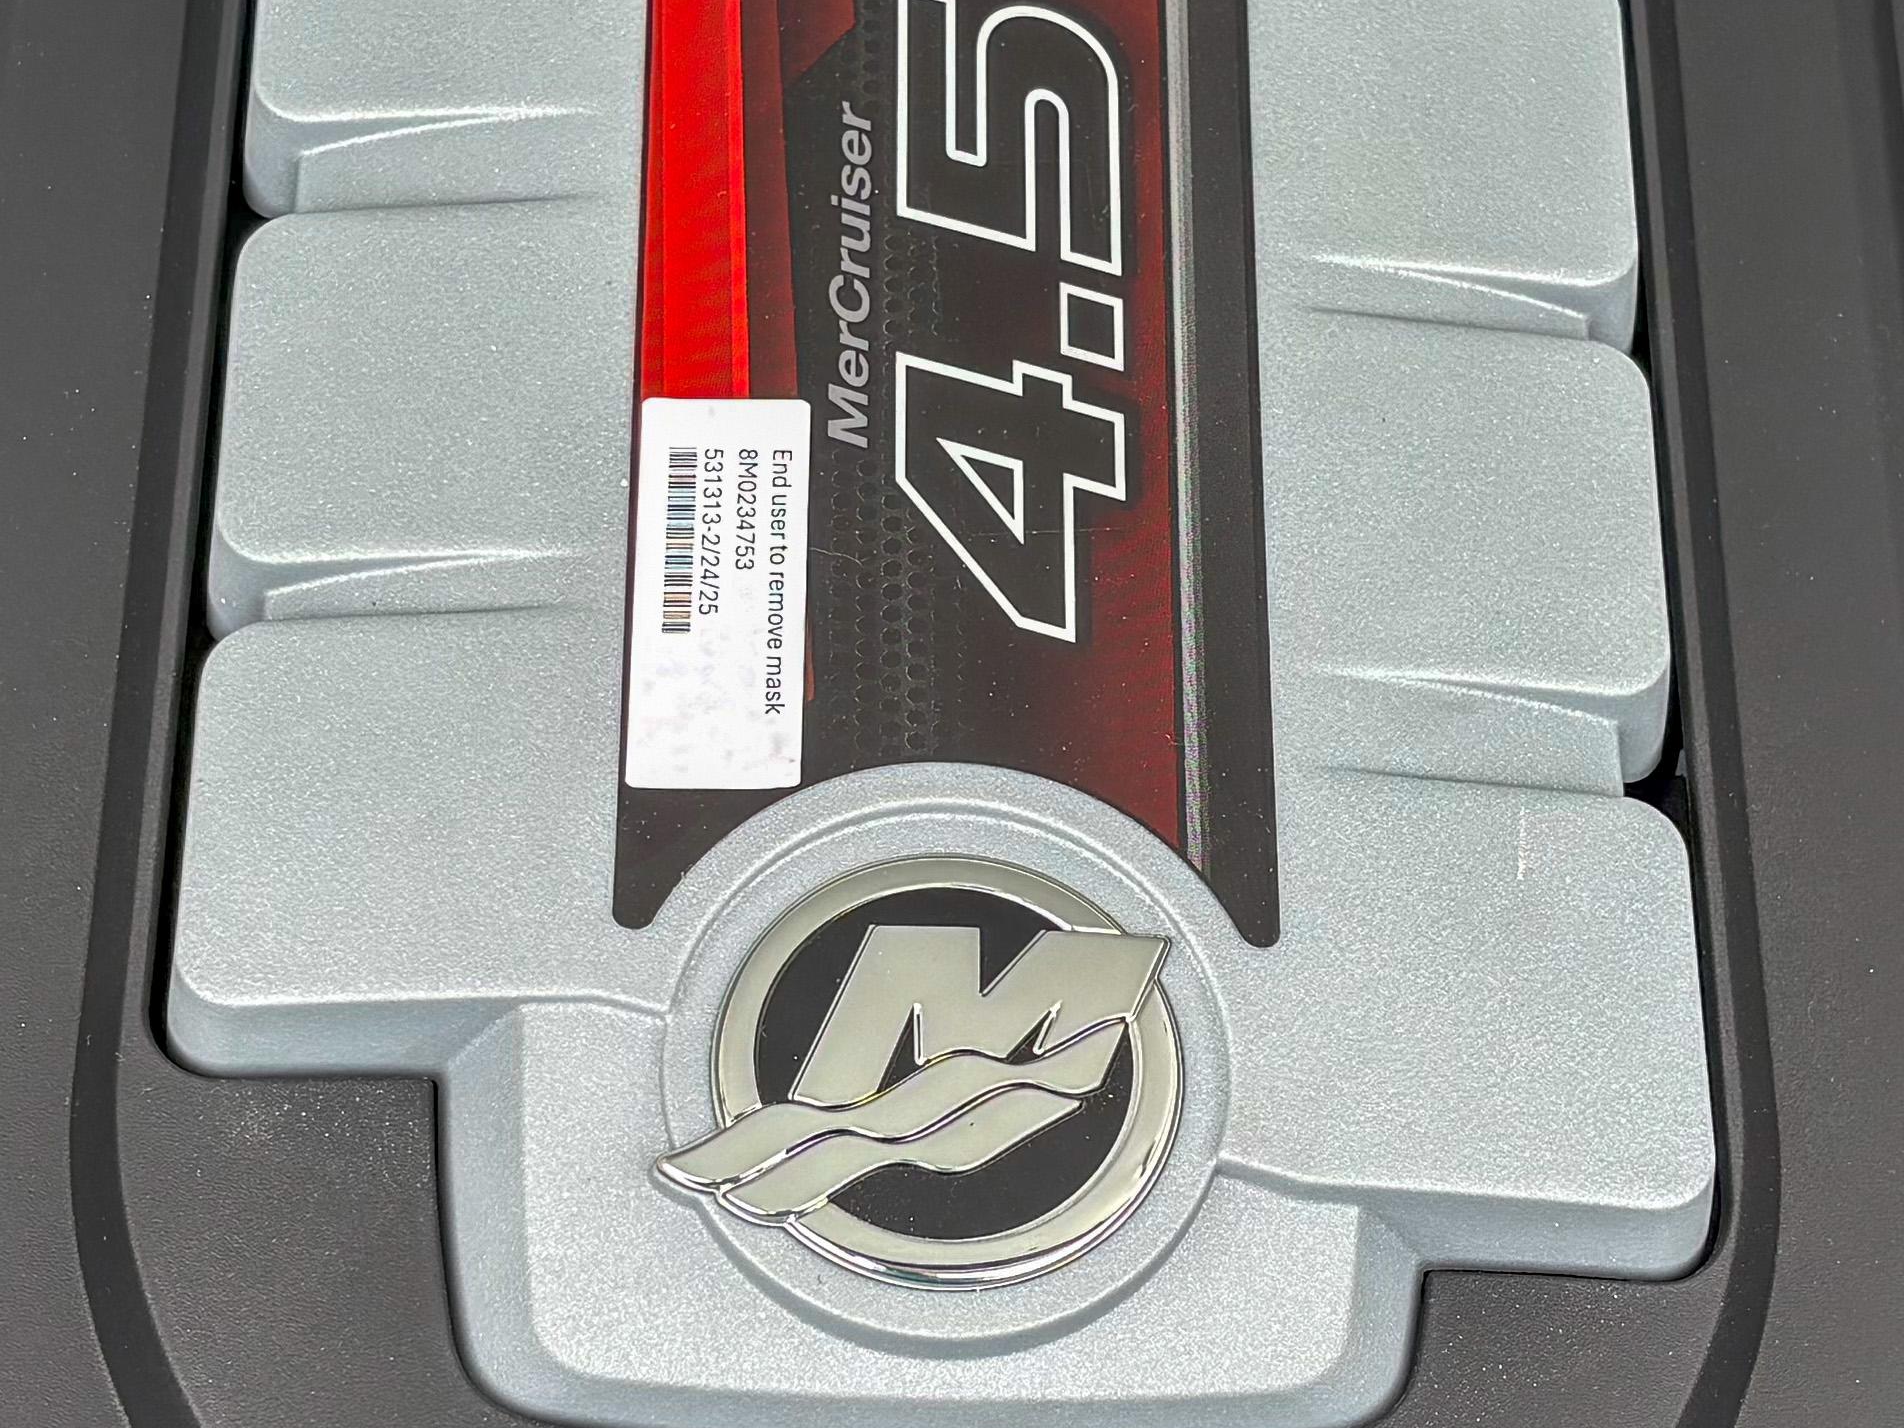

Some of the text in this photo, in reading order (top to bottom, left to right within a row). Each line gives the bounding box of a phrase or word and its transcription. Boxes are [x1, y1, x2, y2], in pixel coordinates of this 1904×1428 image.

[828, 102, 876, 452] MerCruiser
[698, 448, 724, 615] 531313-2/24/25
[735, 448, 759, 570] 8M0234753
[764, 449, 793, 715] End user to remove mask
